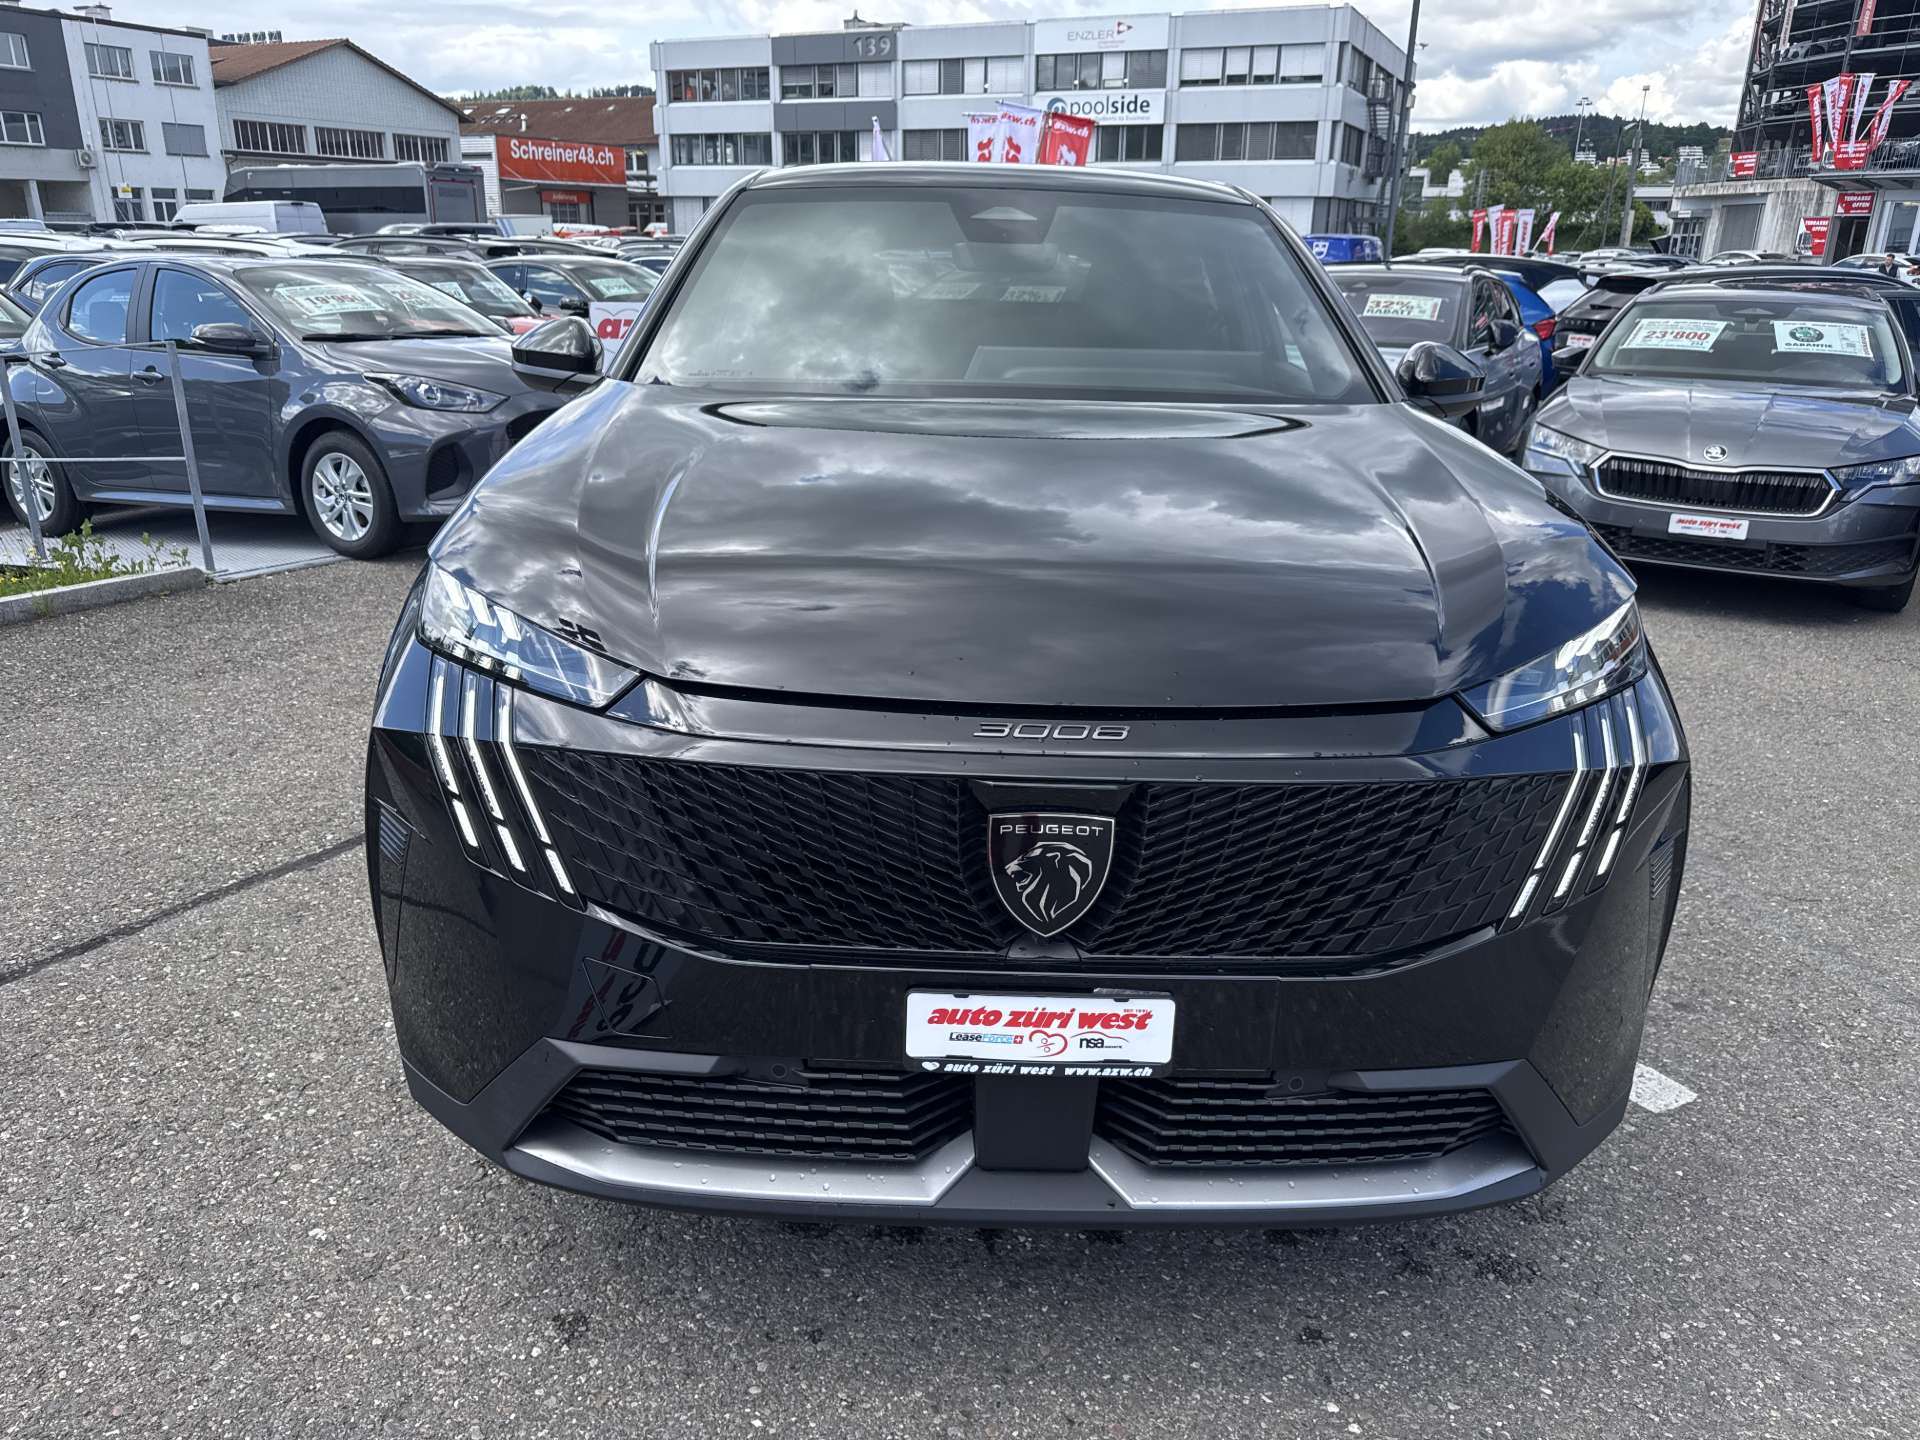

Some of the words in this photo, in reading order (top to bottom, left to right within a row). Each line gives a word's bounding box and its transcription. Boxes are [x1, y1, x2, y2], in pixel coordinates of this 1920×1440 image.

[1067, 30, 1115, 41] ENZLER
[854, 36, 891, 57] 139
[1070, 94, 1151, 115] poolside
[1001, 112, 1037, 127] azw.ch
[1053, 120, 1089, 137] azw.ch
[510, 138, 614, 166] Schreiner48.ch
[1366, 308, 1412, 316] RABATT
[1644, 330, 1711, 341] 23'800
[973, 722, 1131, 740] 3008
[1000, 824, 1104, 837] PEUGEOT
[927, 1006, 997, 1026] auto
[1003, 1007, 1076, 1029] züri
[1078, 1010, 1153, 1030] west
[949, 1032, 1013, 1044] LeaseForce
[1079, 1037, 1104, 1049] nsa
[944, 1063, 979, 1073] auto
[982, 1063, 1016, 1074] züri
[1020, 1065, 1055, 1075] west
[1065, 1067, 1153, 1077] www.azw.ch
